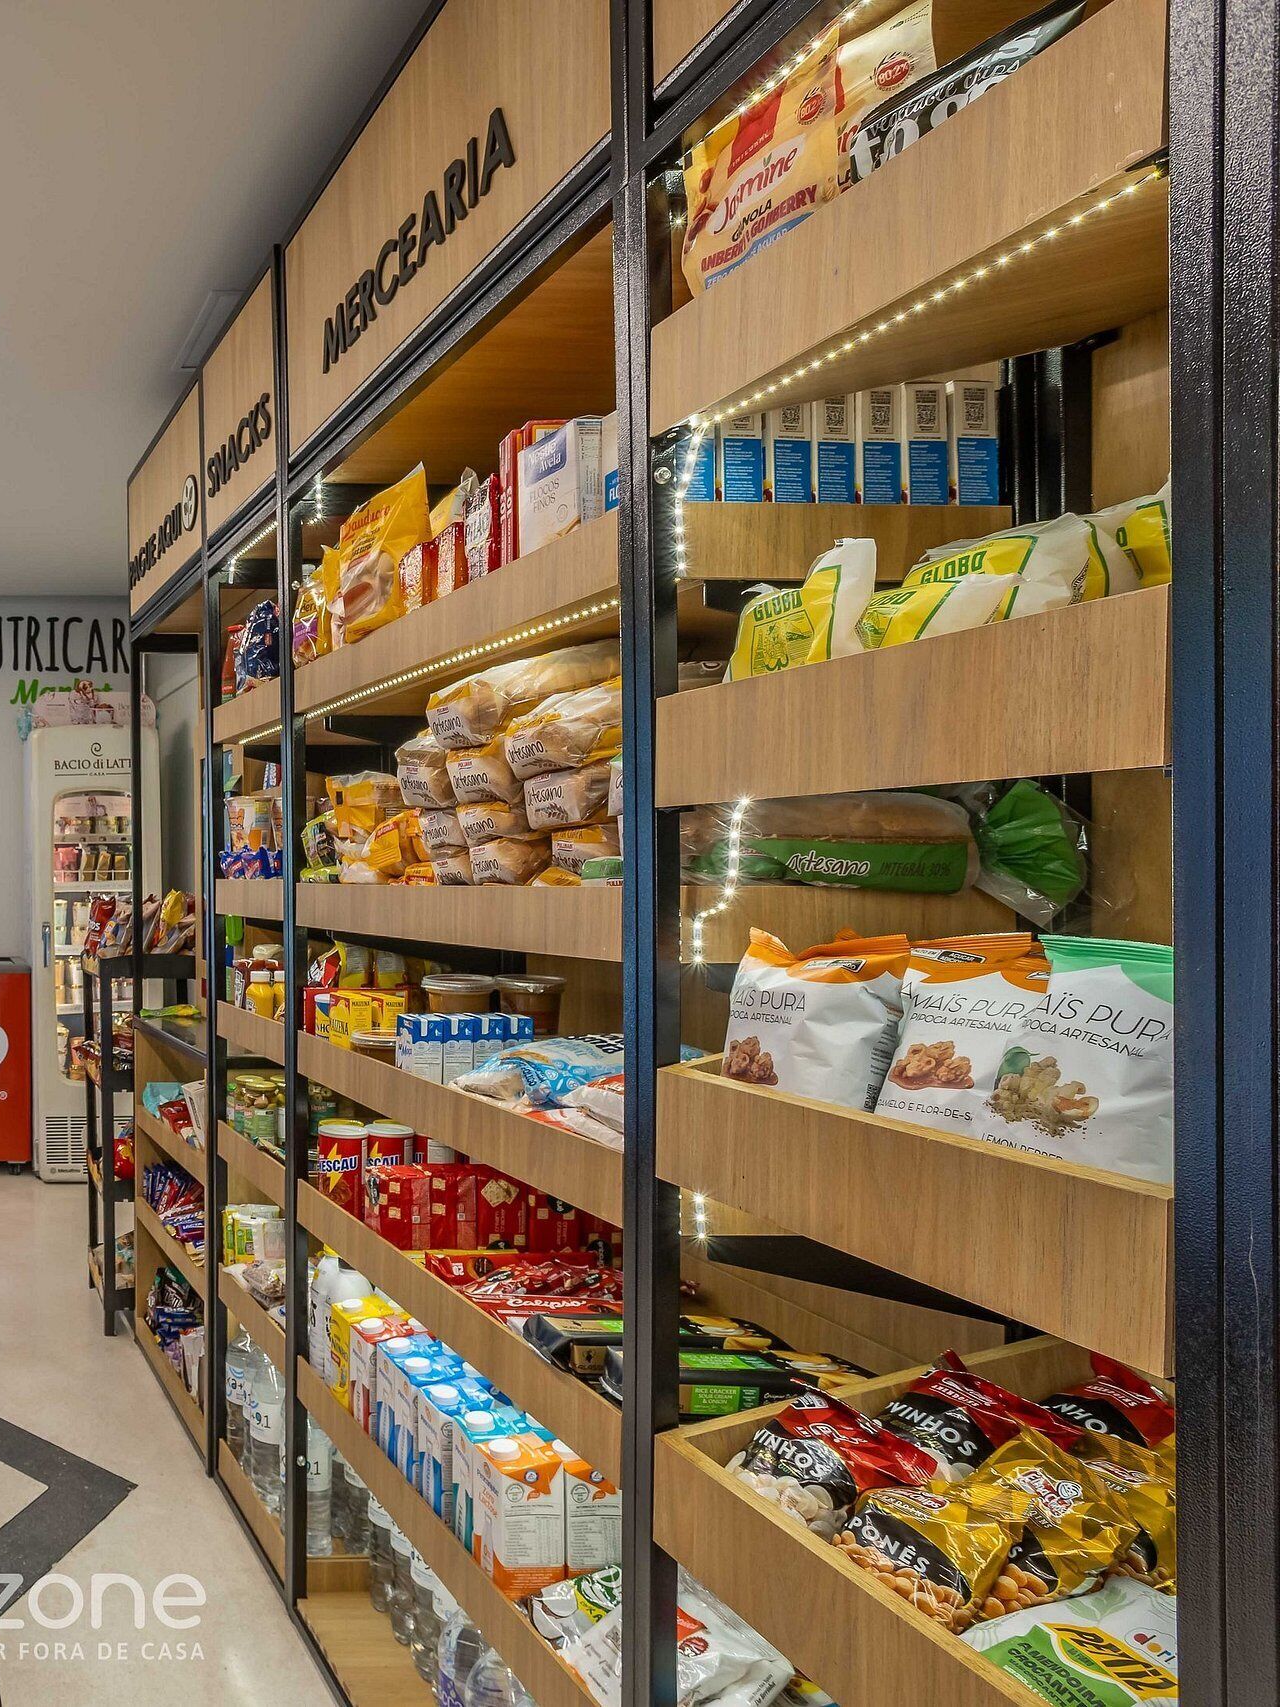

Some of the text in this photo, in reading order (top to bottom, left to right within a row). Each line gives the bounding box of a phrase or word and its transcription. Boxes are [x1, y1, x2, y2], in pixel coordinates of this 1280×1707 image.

[322, 106, 516, 375] MERCEARIA
[207, 392, 272, 498] SNACKS
[529, 476, 561, 500] FLOCOS
[532, 491, 557, 514] FINOS
[129, 502, 183, 590] PAGUE AQUI
[921, 549, 988, 584] GLOBO
[752, 588, 804, 623] GLOBO
[433, 715, 464, 736] artesano
[508, 740, 544, 764] artesano
[53, 759, 92, 771] BACIO
[92, 757, 105, 770] di
[400, 776, 430, 792] artesano
[453, 771, 492, 789] artesano
[526, 785, 563, 807] artesano
[462, 817, 495, 838] artesano
[784, 848, 871, 877] artesano
[879, 861, 927, 877] INTEGRAL
[759, 989, 807, 1012] PURA
[749, 1012, 793, 1025] ARTESANAL
[909, 1012, 1013, 1034] PIPOCA ARTESANAL
[1086, 1003, 1174, 1043] PURA
[1058, 1026, 1145, 1059] ARTESANAL
[907, 1102, 914, 1111] E
[506, 1299, 587, 1310] Calipso
[694, 1387, 709, 1395] RICE
[847, 1514, 931, 1573] PONÊS
[1133, 1632, 1177, 1663] dori
